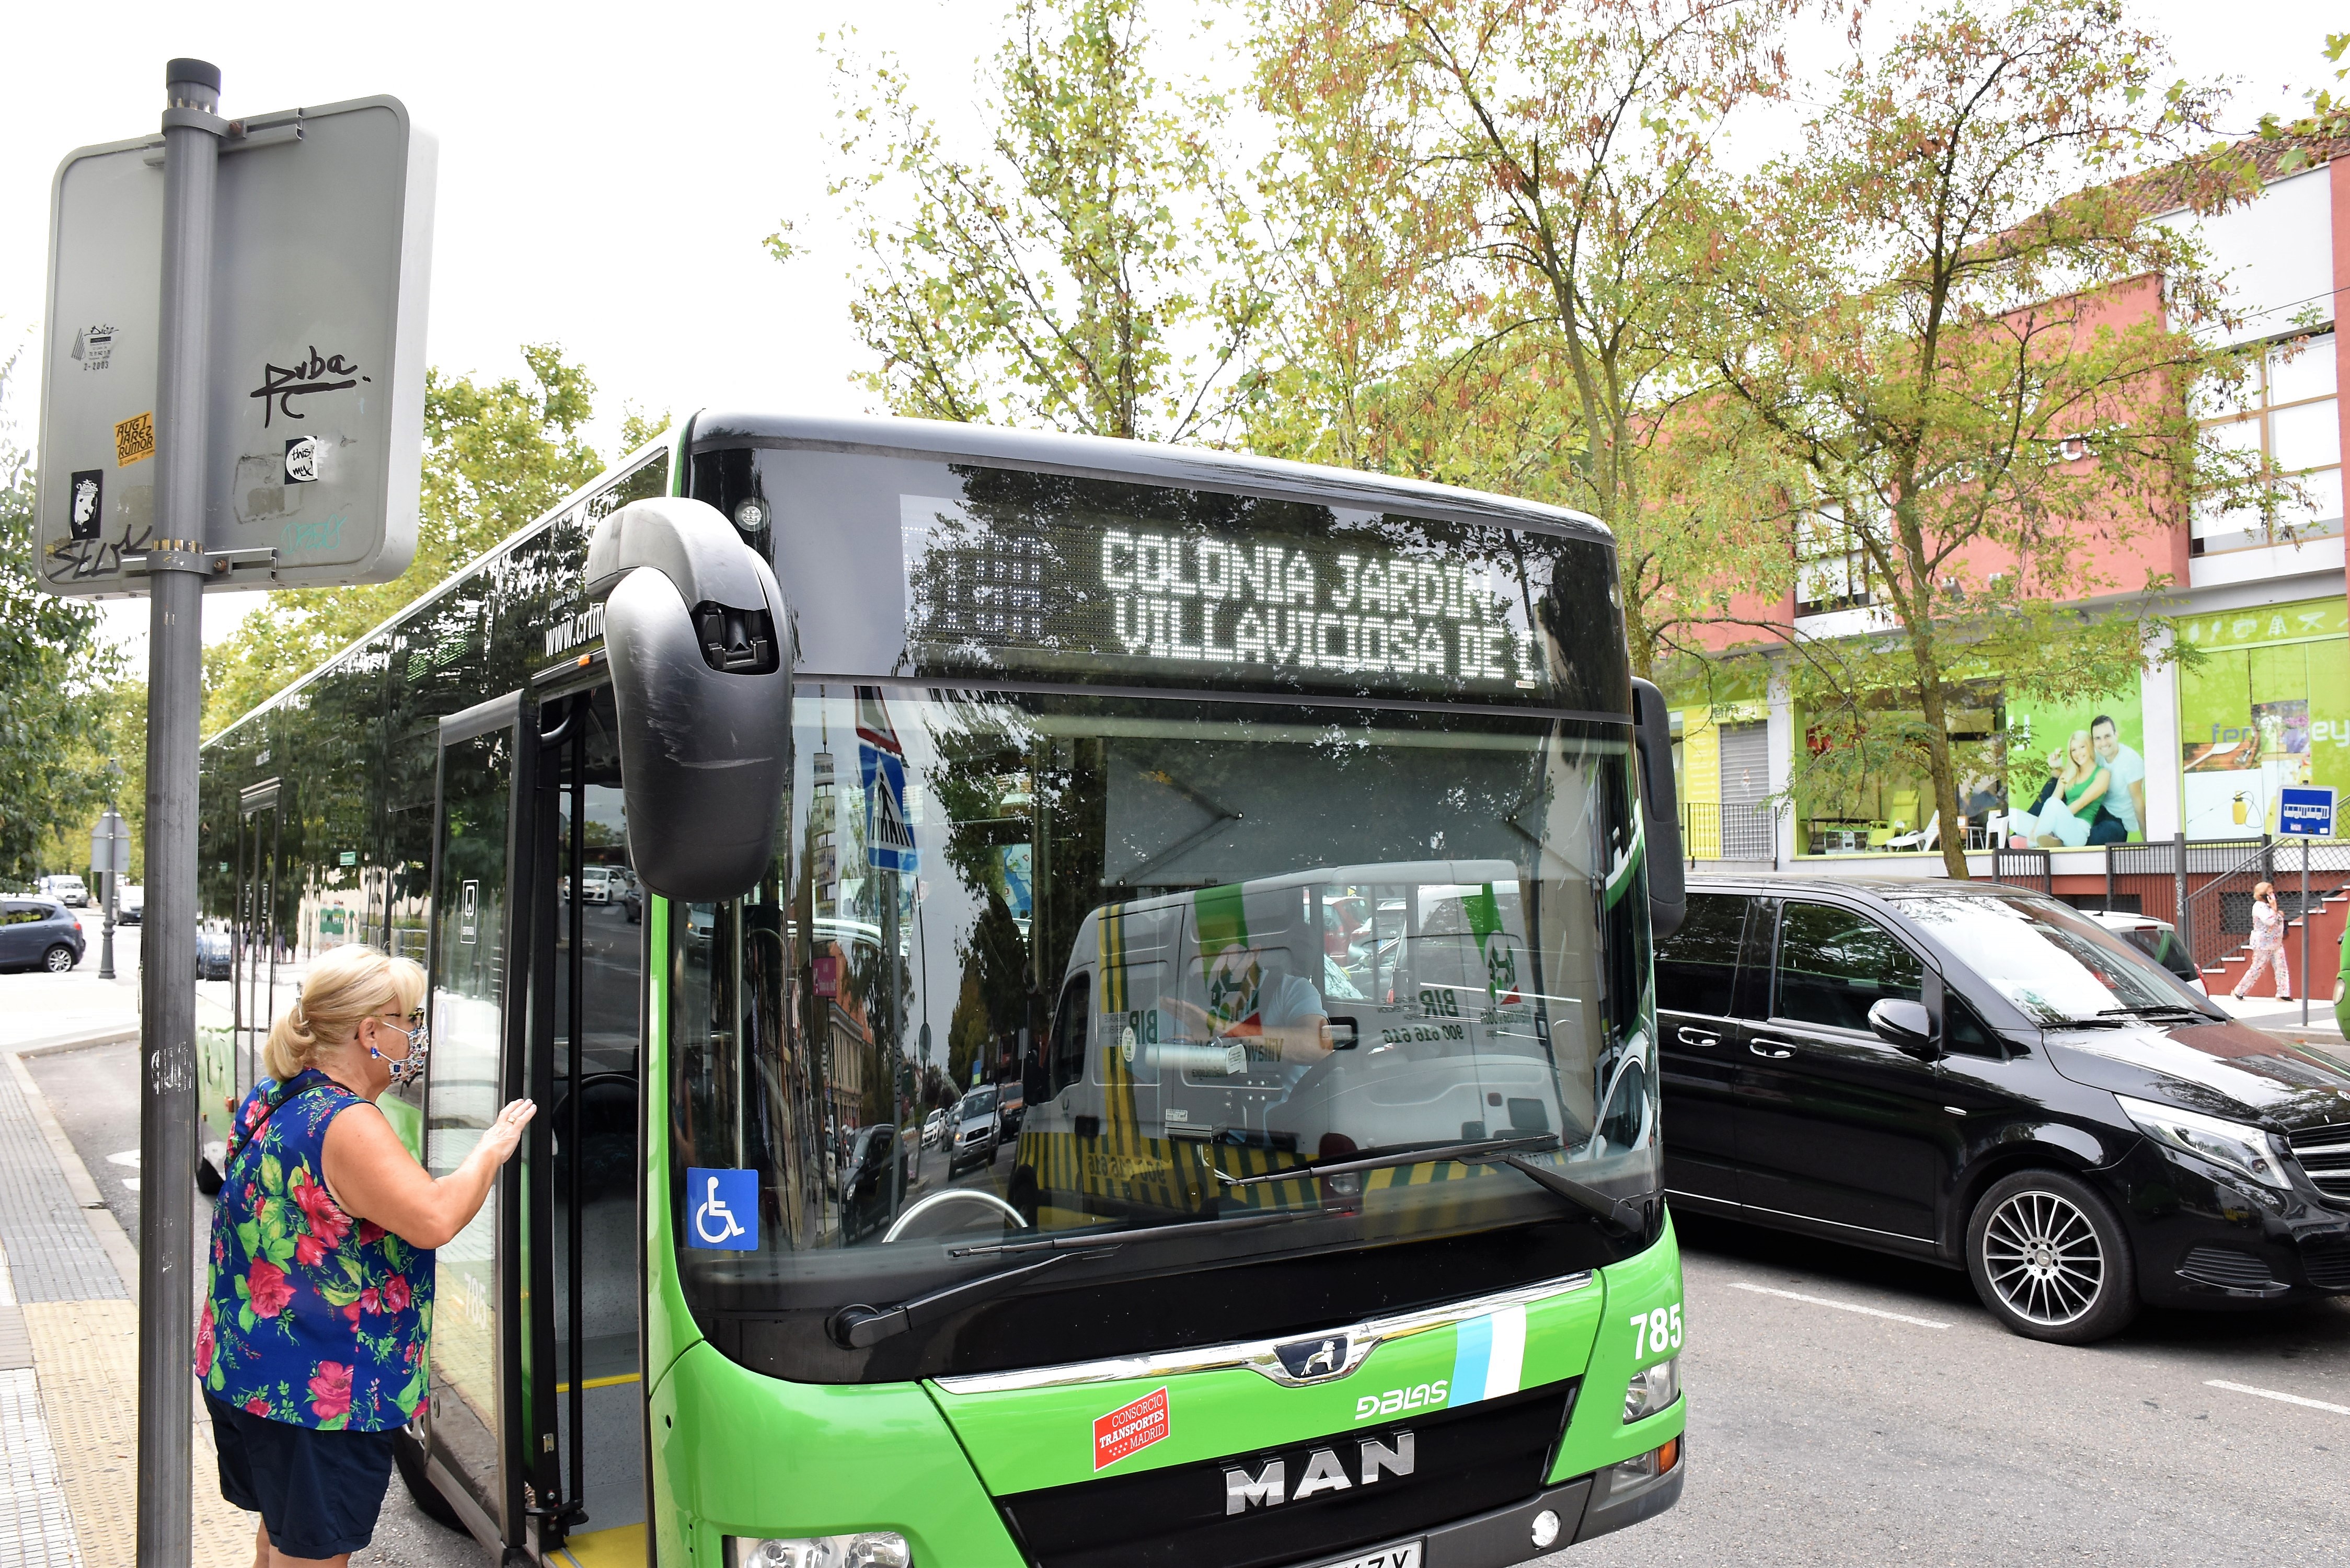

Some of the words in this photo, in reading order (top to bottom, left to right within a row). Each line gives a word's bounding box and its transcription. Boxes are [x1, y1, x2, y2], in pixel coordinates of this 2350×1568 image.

[119, 436, 153, 458] RUMOR
[292, 448, 310, 460] this
[1102, 530, 1315, 605] COLONIA
[1331, 555, 1491, 621] JARDIN
[1115, 595, 1444, 675] VILLAVICIOSA
[1460, 625, 1505, 679] DE
[1630, 1302, 1682, 1360] 785
[1099, 1409, 1165, 1448] TRANSPORTES
[1112, 1394, 1164, 1427] CONSORCIO
[1130, 1423, 1165, 1449] MADRID
[1226, 1433, 1414, 1515] MAN
